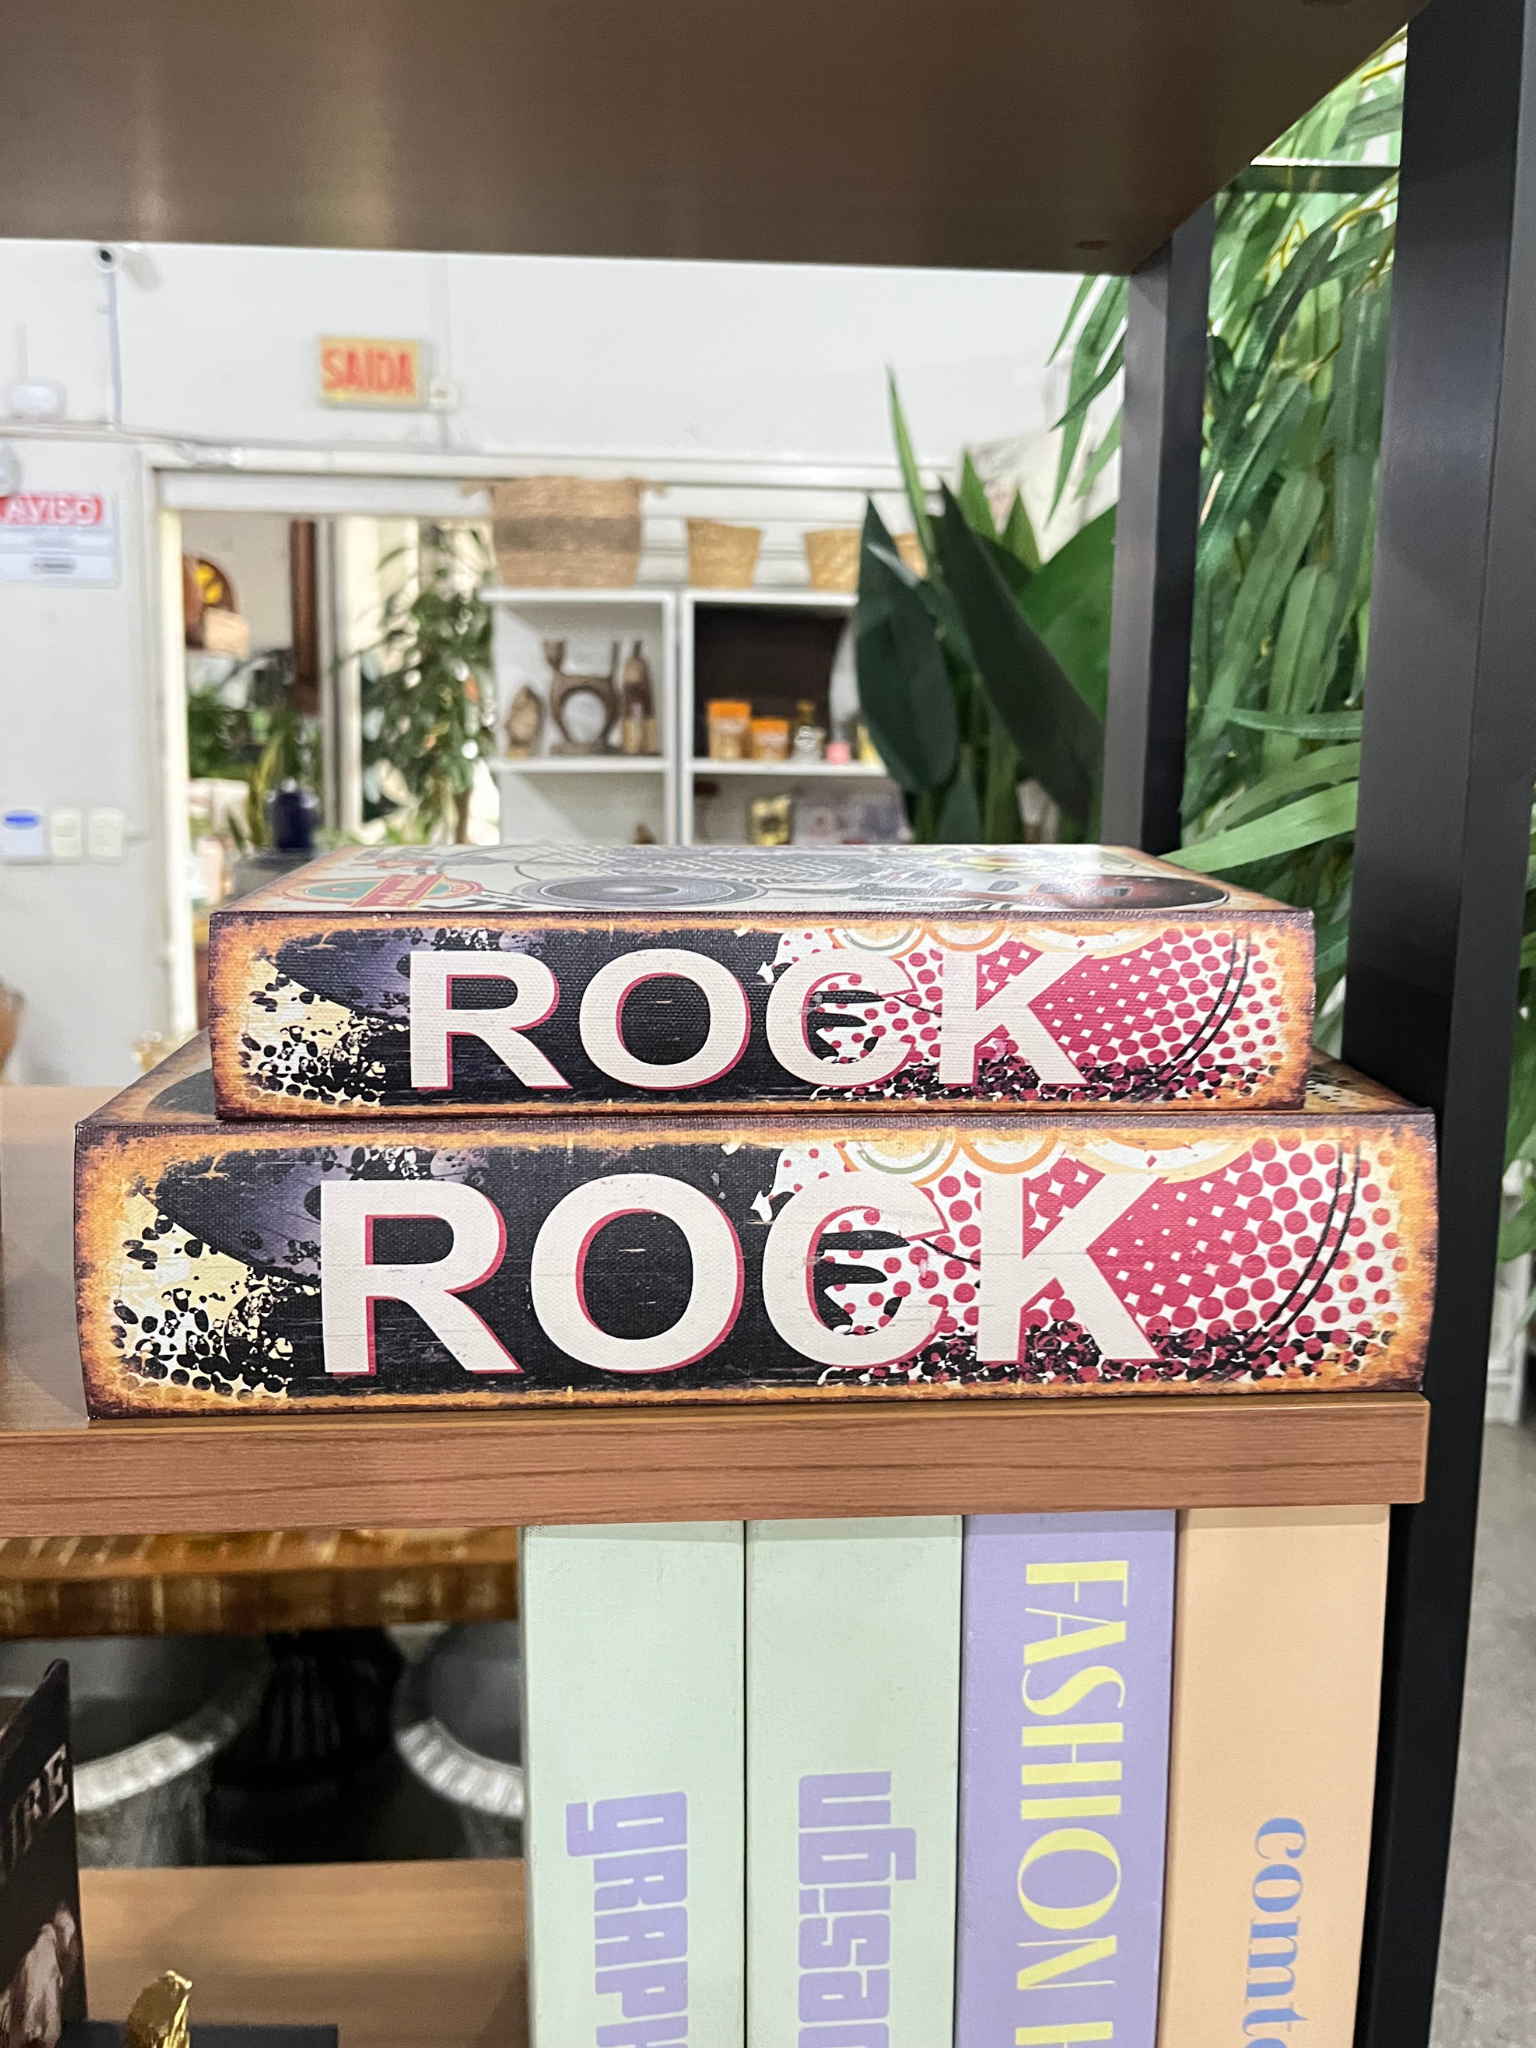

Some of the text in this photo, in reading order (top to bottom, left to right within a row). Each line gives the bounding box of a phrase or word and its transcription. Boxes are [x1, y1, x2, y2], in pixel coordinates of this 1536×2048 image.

[409, 948, 1091, 1093] ROCK
[319, 1172, 1160, 1377] ROCK
[1016, 1559, 1129, 1991] FASHION
